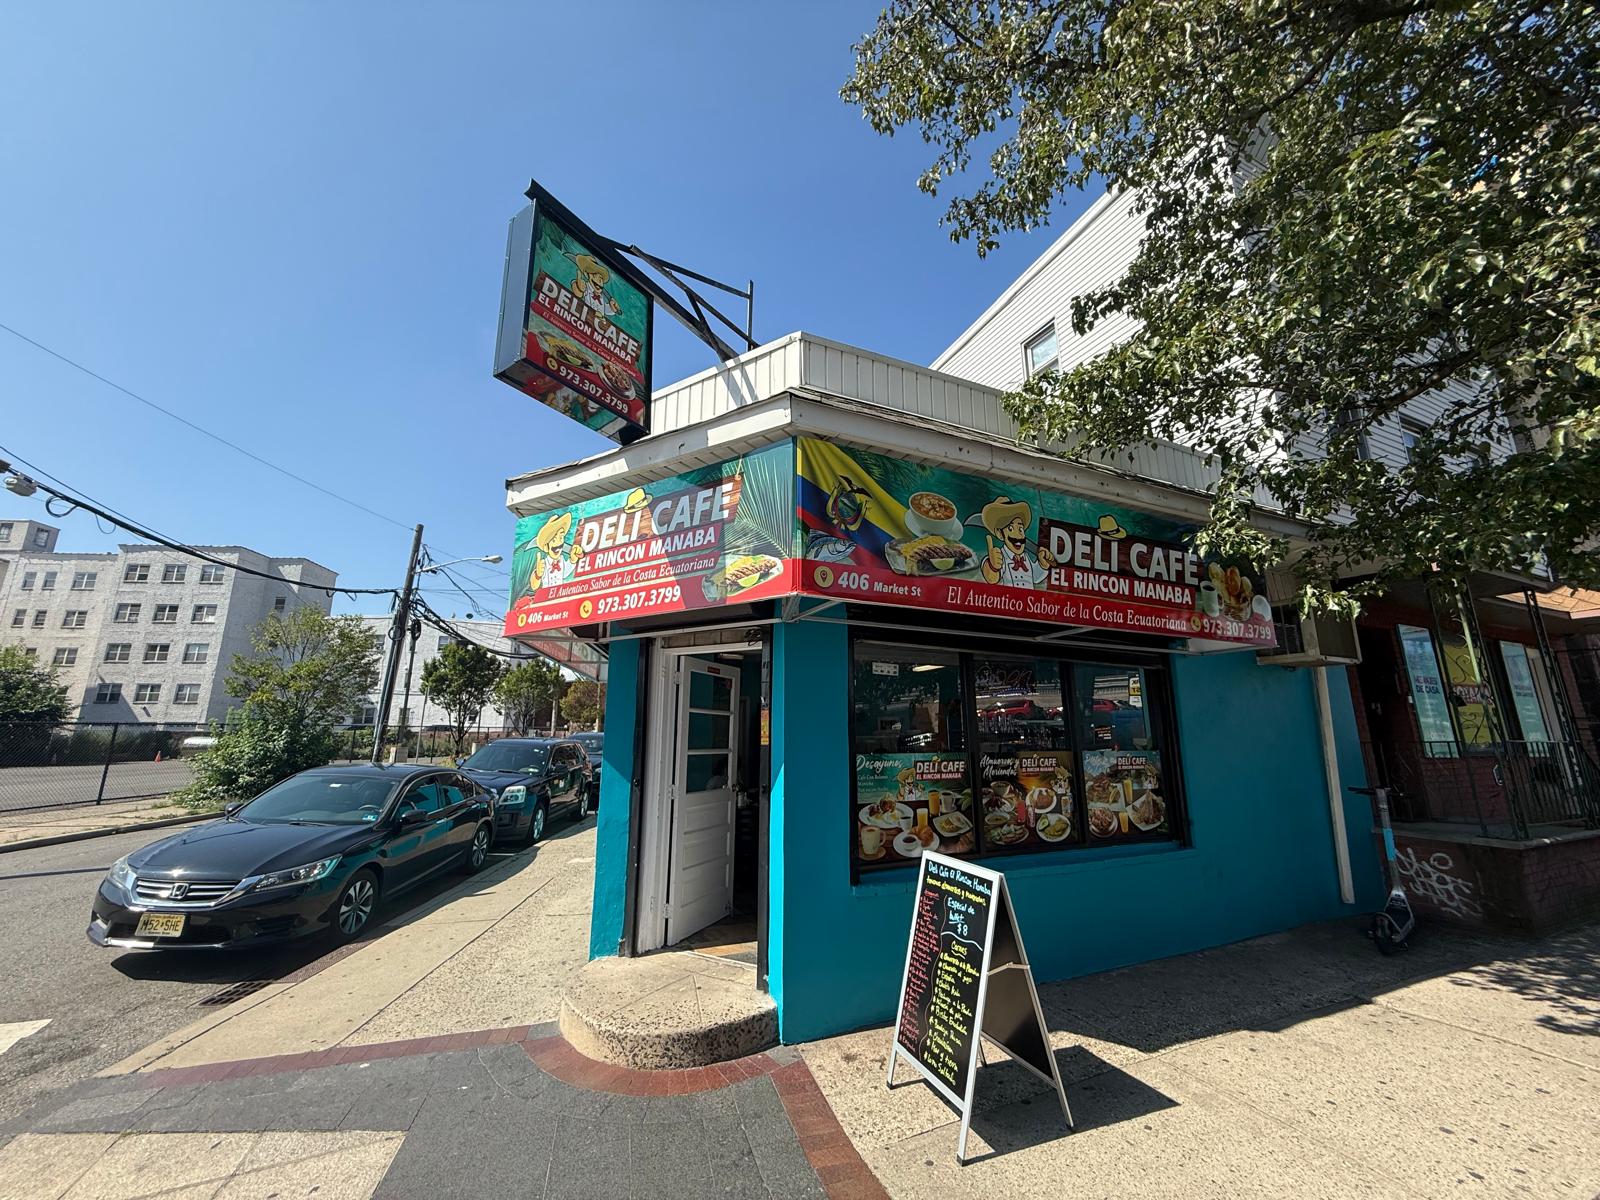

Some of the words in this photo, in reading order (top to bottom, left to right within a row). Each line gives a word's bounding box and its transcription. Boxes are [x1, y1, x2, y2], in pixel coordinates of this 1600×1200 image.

[538, 294, 550, 308] EL
[554, 305, 592, 335] RINCON
[593, 332, 632, 363] MANABA
[542, 277, 588, 320] DELI
[594, 317, 639, 357] CAFE
[560, 366, 628, 414] 973.307.3799
[582, 511, 642, 552] DELI
[652, 482, 733, 535] CAFE
[577, 557, 591, 573] EL
[594, 544, 646, 570] RINCON
[649, 527, 716, 555] MANABA
[1050, 527, 1119, 572] DELI
[1129, 543, 1199, 585] CAFE
[549, 586, 558, 598] El
[557, 581, 589, 598] Autentico
[590, 578, 611, 591] Sabor
[612, 575, 622, 586] de
[622, 573, 631, 584] la
[633, 569, 657, 582] Costa
[659, 558, 715, 576] Ecuatoriana
[838, 571, 870, 592] 406
[873, 580, 909, 597] Market
[911, 585, 922, 597] St
[1051, 568, 1068, 587] EL
[1073, 571, 1130, 596] RINCON
[1133, 581, 1192, 605] MANABA
[527, 611, 543, 624] 406
[543, 612, 562, 623] Market
[562, 611, 569, 619] St
[597, 585, 681, 615] 973.307.3799
[947, 586, 961, 604] El
[965, 590, 1024, 612] Autentico
[1026, 596, 1061, 617] Sabor
[1063, 604, 1077, 618] de
[1079, 602, 1090, 619] la
[1092, 605, 1124, 624] Costa
[1126, 609, 1187, 631] Ecuatoriana
[1203, 617, 1272, 640] 973.307.3799
[916, 761, 938, 773] DELI
[941, 761, 965, 773] CAFE
[1022, 758, 1038, 767] DELI
[1039, 758, 1057, 767] CAFE
[1118, 757, 1131, 765] DELI
[1132, 757, 1146, 765] CAFE
